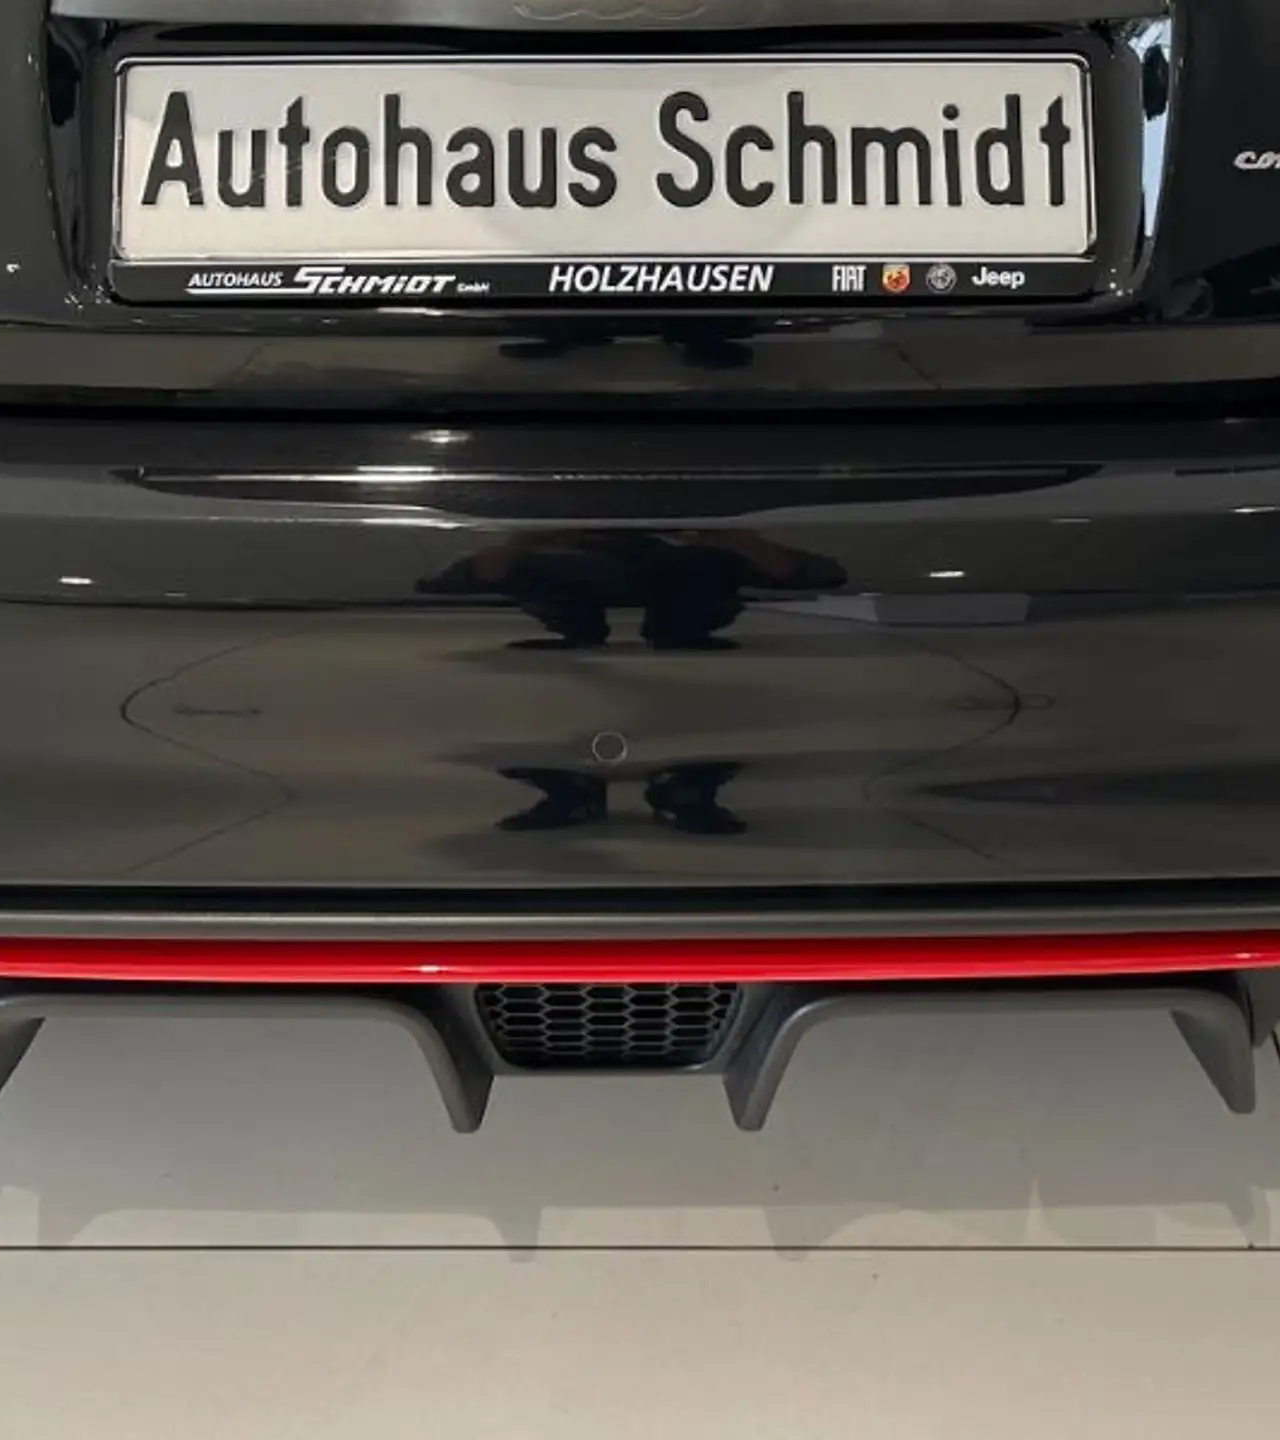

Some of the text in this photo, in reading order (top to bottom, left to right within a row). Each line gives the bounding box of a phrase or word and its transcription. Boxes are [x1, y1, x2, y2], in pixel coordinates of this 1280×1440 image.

[140, 90, 1072, 208] Autohaus Schmidt
[188, 272, 283, 288] AUTOHAUS
[548, 264, 775, 293] HOLZHAUSEN
[832, 264, 867, 292] FIAT
[972, 266, 1025, 289] Jeep
